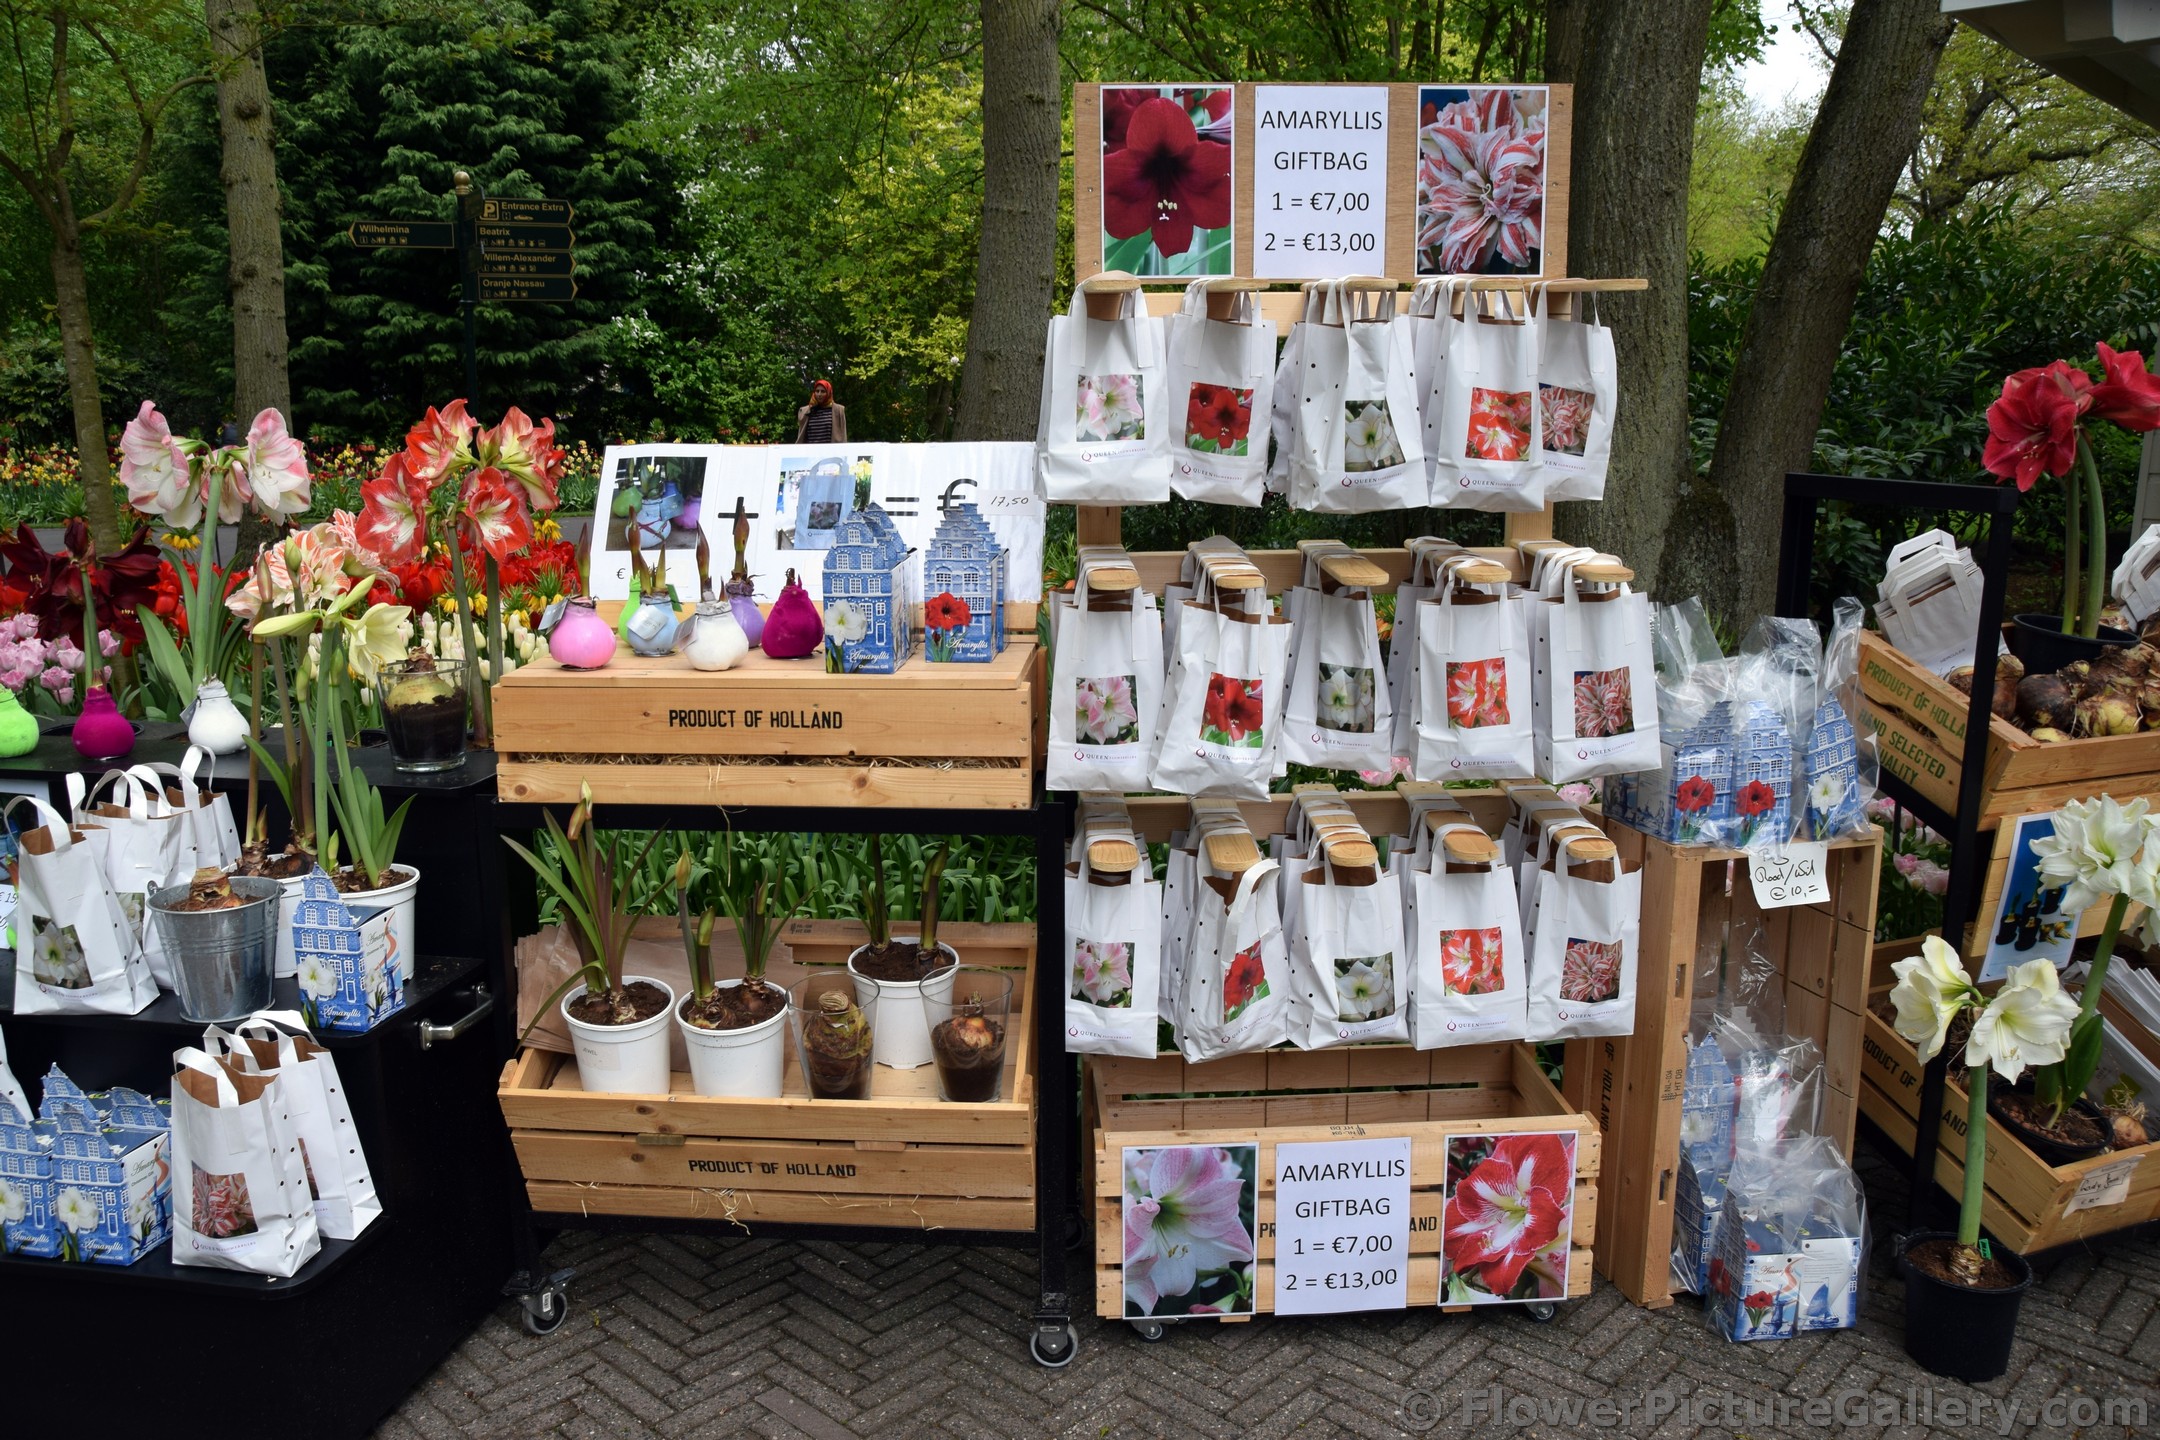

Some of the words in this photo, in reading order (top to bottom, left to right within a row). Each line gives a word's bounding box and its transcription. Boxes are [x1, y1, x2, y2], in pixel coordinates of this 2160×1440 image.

[1261, 110, 1382, 130] AMARYLLIS
[1274, 151, 1368, 171] GIFTBAG
[501, 202, 540, 211] Entrance
[541, 203, 564, 211] Extra
[1272, 192, 1283, 211] 1
[1291, 198, 1303, 207] =
[1309, 191, 1370, 215] €7,00
[360, 224, 410, 234] Wilhelmina
[479, 227, 511, 236] Beatrix
[1264, 232, 1276, 251] 2
[1284, 239, 1295, 247] =
[1302, 231, 1375, 255] €13,00
[482, 278, 512, 289] Oranje
[513, 280, 545, 288] Nassau
[1093, 450, 1117, 459] QUEEN
[1192, 466, 1214, 478] QUEEN
[1353, 477, 1378, 485] QUEEN
[1472, 479, 1496, 487] QUEEN
[990, 495, 1029, 508] 17,50
[945, 637, 988, 653] Amaryllis
[846, 649, 889, 664] Amaryllis
[1864, 659, 1914, 701] PRODUCT
[1912, 692, 1931, 713] OF
[1929, 704, 1966, 740] HOLLA
[668, 709, 737, 728] PRODUCT
[744, 710, 763, 728] OF
[770, 710, 843, 730] HOLLAND
[1086, 752, 1109, 762] QUEEN
[1208, 750, 1232, 762] QUEEN
[1589, 747, 1612, 757] QUEEN
[1888, 730, 1947, 780] SELECTED
[1462, 759, 1486, 767] QUEEN
[320, 1004, 361, 1020] Amaryllis
[1569, 1012, 1592, 1021] QUEEN
[1350, 1027, 1372, 1037] QUEEN
[1458, 1022, 1480, 1030] QUEEN
[1080, 1030, 1102, 1039] QUEEN
[1604, 1041, 1614, 1062] OF
[1863, 1033, 1900, 1075] RODUCT
[1899, 1069, 1917, 1089] OF
[1600, 1067, 1613, 1132] HOLLAND
[688, 1159, 753, 1174] PRODUCT
[761, 1162, 779, 1175] OF
[786, 1163, 857, 1177] HOLLAND
[1281, 1159, 1405, 1183] AMARYLLIS
[1295, 1197, 1391, 1219] GIFTBAG
[8, 1229, 50, 1244] Amaryllis
[82, 1237, 124, 1253] Amaryllis
[1294, 1238, 1305, 1255] 1
[1313, 1243, 1325, 1251] =
[1332, 1234, 1393, 1256] €7,00
[1286, 1274, 1298, 1291] 2
[1305, 1278, 1318, 1288] =
[1324, 1268, 1398, 1290] €13,00
